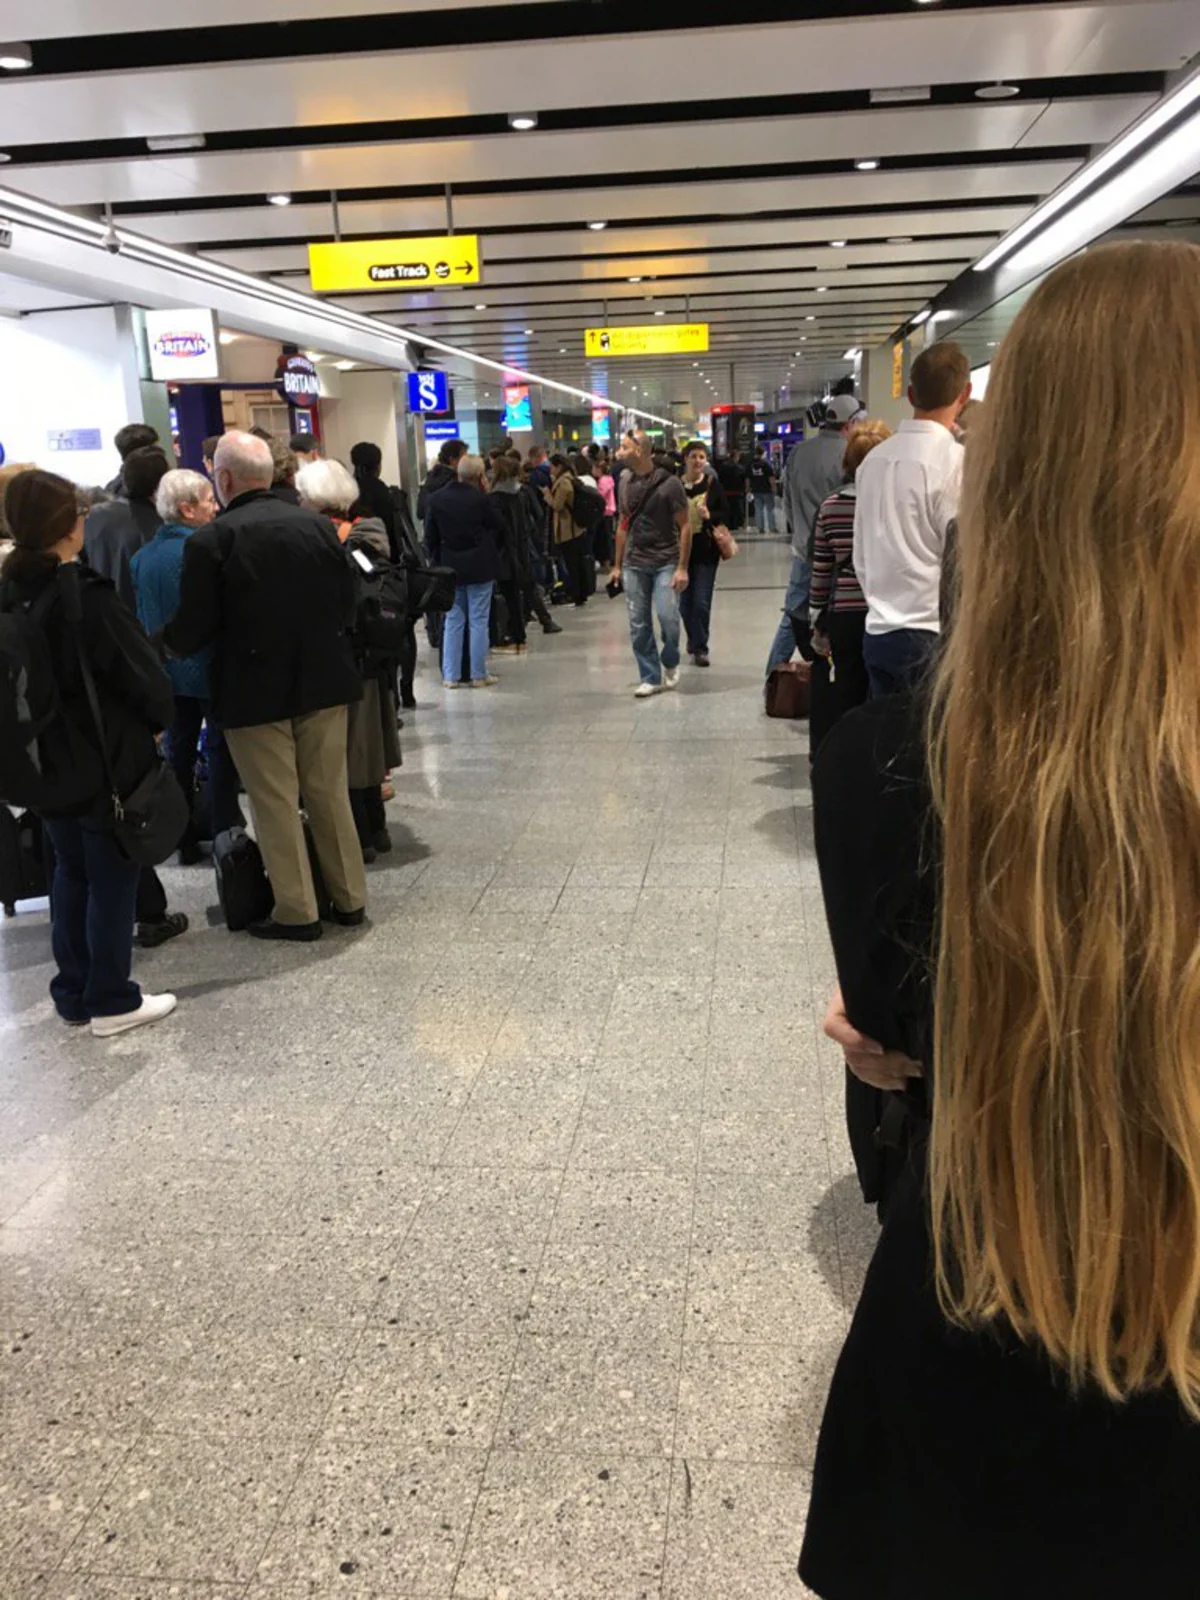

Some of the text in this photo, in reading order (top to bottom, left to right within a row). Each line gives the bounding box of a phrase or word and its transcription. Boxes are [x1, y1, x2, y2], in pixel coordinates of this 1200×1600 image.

[371, 263, 428, 279] Fast Track
[155, 340, 209, 354] BRITAIN
[284, 372, 321, 393] BRITAIN
[419, 382, 438, 411] S
